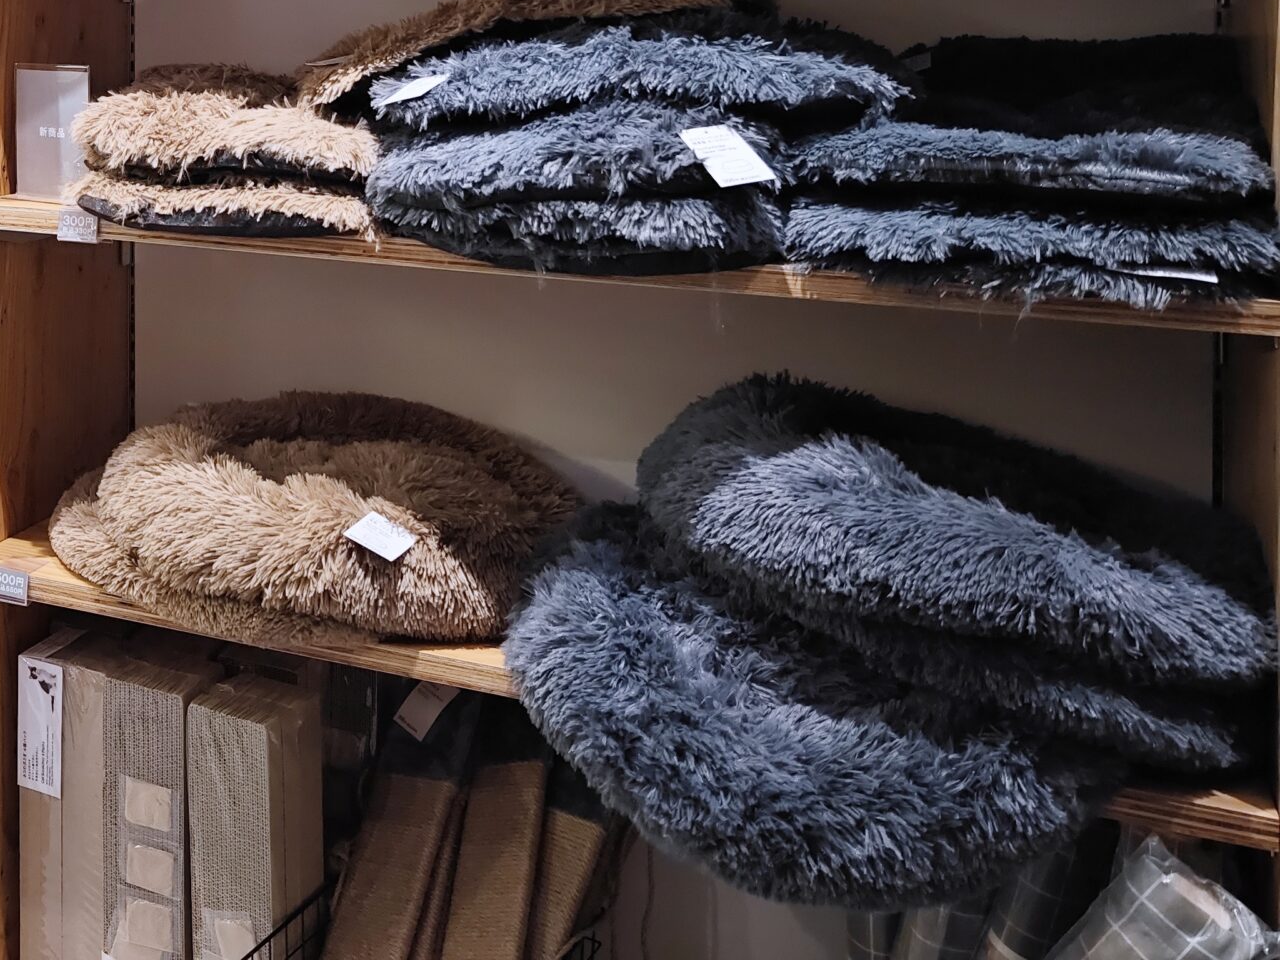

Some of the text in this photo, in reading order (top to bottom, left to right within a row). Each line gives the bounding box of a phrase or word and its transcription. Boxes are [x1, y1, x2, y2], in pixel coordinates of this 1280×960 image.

[39, 126, 65, 138] 新商品
[63, 215, 94, 229] 300円
